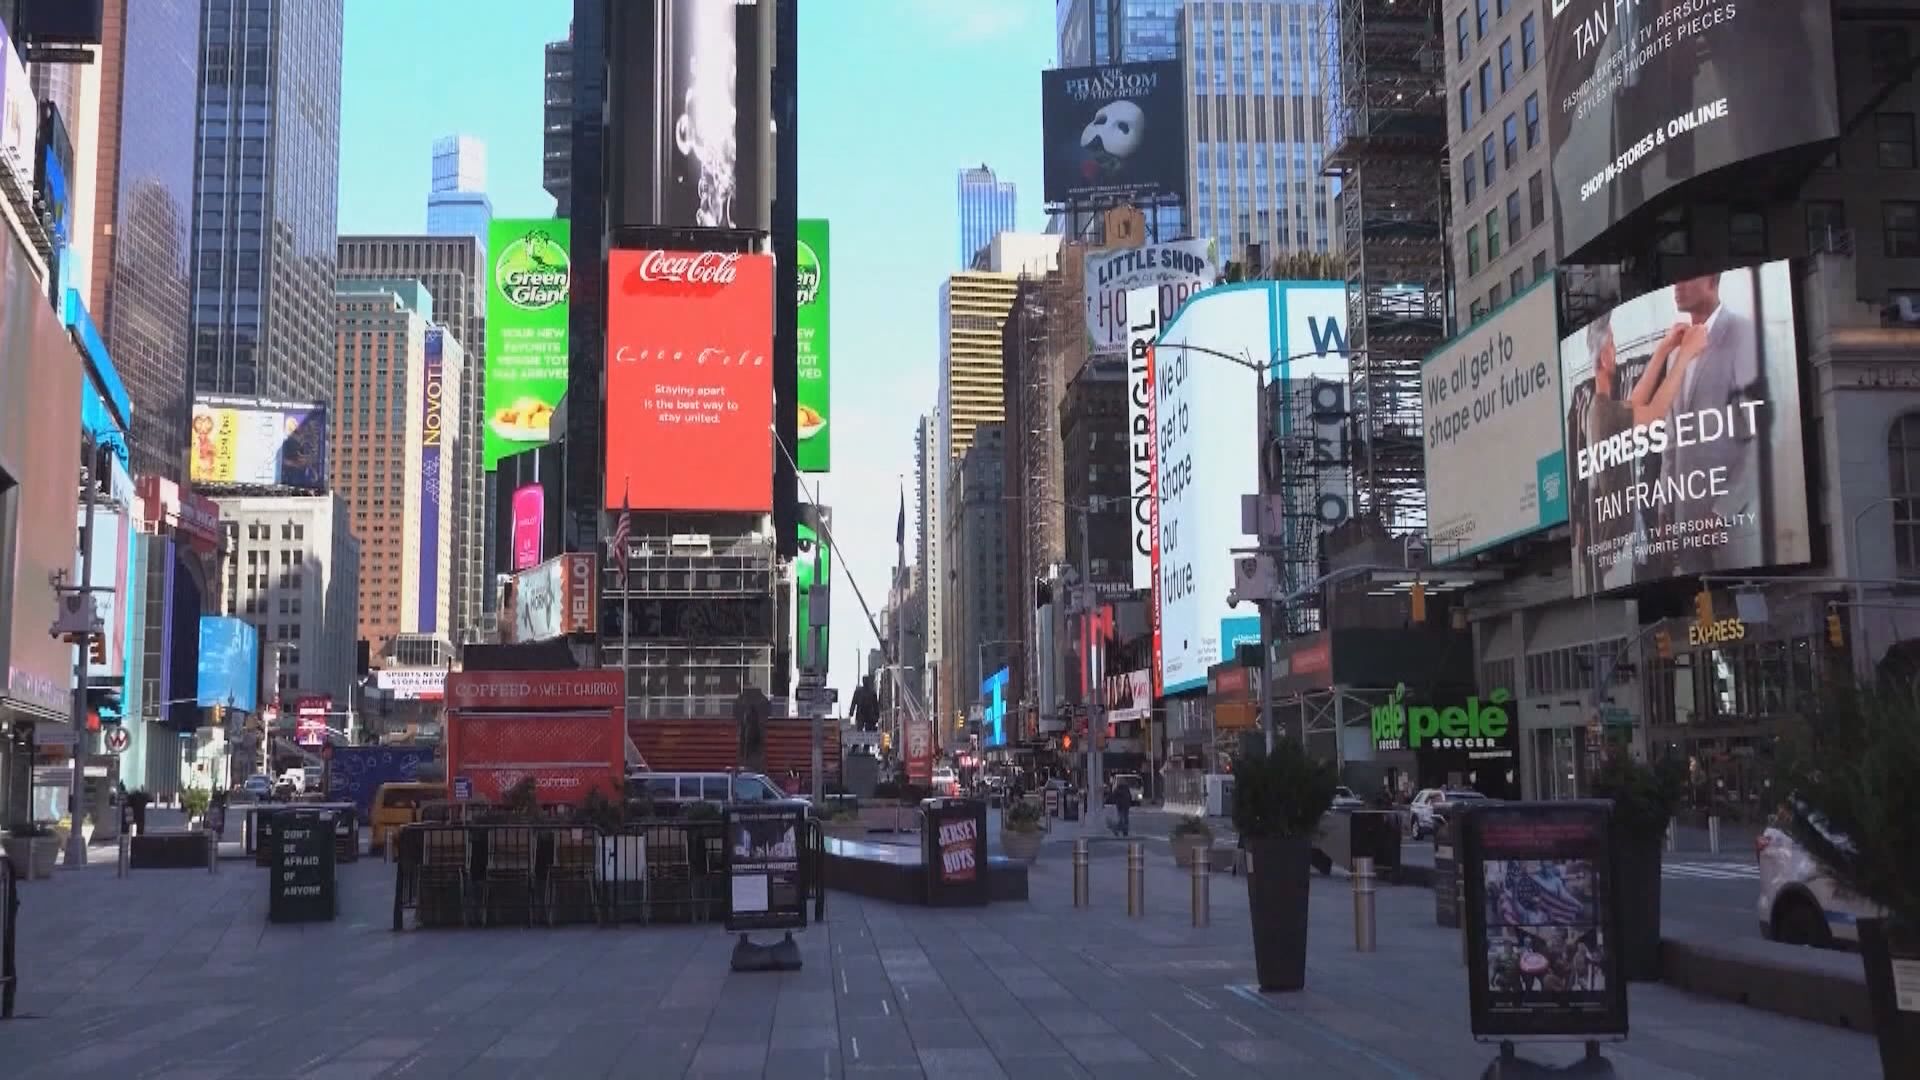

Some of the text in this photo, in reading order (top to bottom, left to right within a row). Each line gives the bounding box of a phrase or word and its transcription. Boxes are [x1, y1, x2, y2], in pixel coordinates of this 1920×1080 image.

[1573, 2, 1607, 61] TAN
[1562, 76, 1596, 112] FASHION
[1596, 46, 1628, 81] EXPERT
[1640, 23, 1652, 42] TV
[1577, 88, 1607, 119] STYLES
[1608, 72, 1623, 92] HIS
[1624, 31, 1673, 78] FAVORITE
[1677, 4, 1736, 41] PIECES
[1065, 72, 1158, 95] PHANTOM
[1580, 97, 1728, 202] SHOP IN-STORES & ONLINE
[505, 271, 568, 287] Green
[640, 248, 742, 284] Coca-Cola
[1098, 247, 1205, 285] LITTLE SHOP
[511, 286, 569, 303] Giant
[1159, 335, 1189, 403] We all
[1428, 331, 1513, 408] We all get to
[645, 400, 739, 411] is the best way to
[655, 384, 725, 399] Staying apart
[1429, 361, 1550, 449] shape our future.
[658, 413, 681, 425] stay
[1131, 308, 1158, 557] COVERGIRL
[1160, 400, 1190, 465] get to
[1577, 400, 1765, 481] EXPRESS EDIT
[1162, 450, 1192, 505] shape
[1594, 465, 1729, 524] TAN FRANCE
[1163, 517, 1179, 555] our
[1649, 527, 1661, 539] TV
[1665, 512, 1757, 536] PERSONALITY
[1634, 540, 1679, 559] FAVORITE
[1683, 532, 1729, 550] PIECES
[1164, 558, 1195, 607] future.
[1688, 617, 1745, 646] EXPRESS
[455, 683, 531, 698] COFFEED
[538, 683, 572, 697] SWEET
[573, 682, 618, 697] CHURROS
[1408, 687, 1511, 750] pelé
[1431, 738, 1497, 749] SOCCER
[283, 829, 312, 840] DON'T
[938, 817, 978, 848] JERSEY
[283, 855, 321, 867] AFRAID
[943, 848, 975, 874] BOYS
[283, 885, 322, 897] ANYONE
